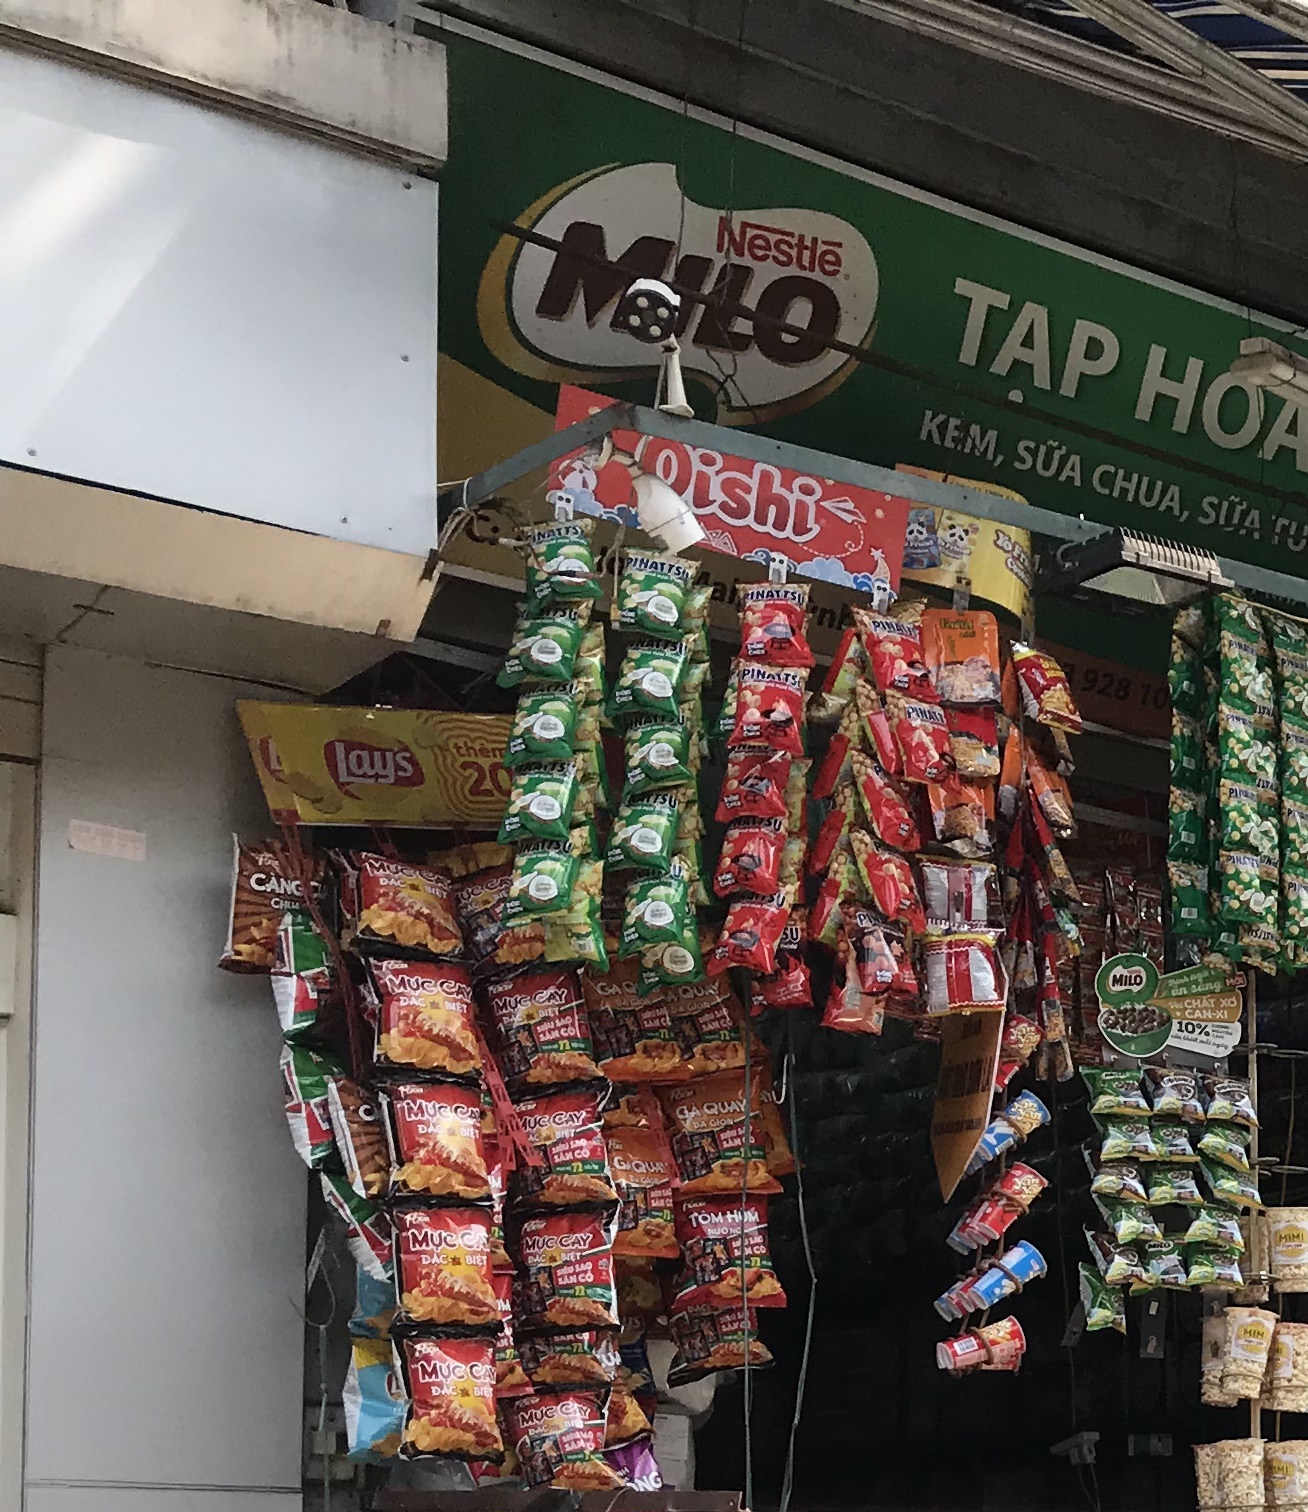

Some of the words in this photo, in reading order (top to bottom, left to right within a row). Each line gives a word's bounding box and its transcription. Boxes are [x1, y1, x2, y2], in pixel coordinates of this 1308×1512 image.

[954, 276, 1120, 404] TẠP
[919, 410, 1004, 467] KEM,
[1013, 440, 1084, 489] SỮA
[1092, 464, 1190, 523] CHUA,
[652, 434, 825, 541] Oishi
[1111, 973, 1144, 988] MILO
[1176, 1021, 1211, 1037] 10%
[558, 1233, 592, 1249] CAY
[1278, 1232, 1305, 1244] MIMI
